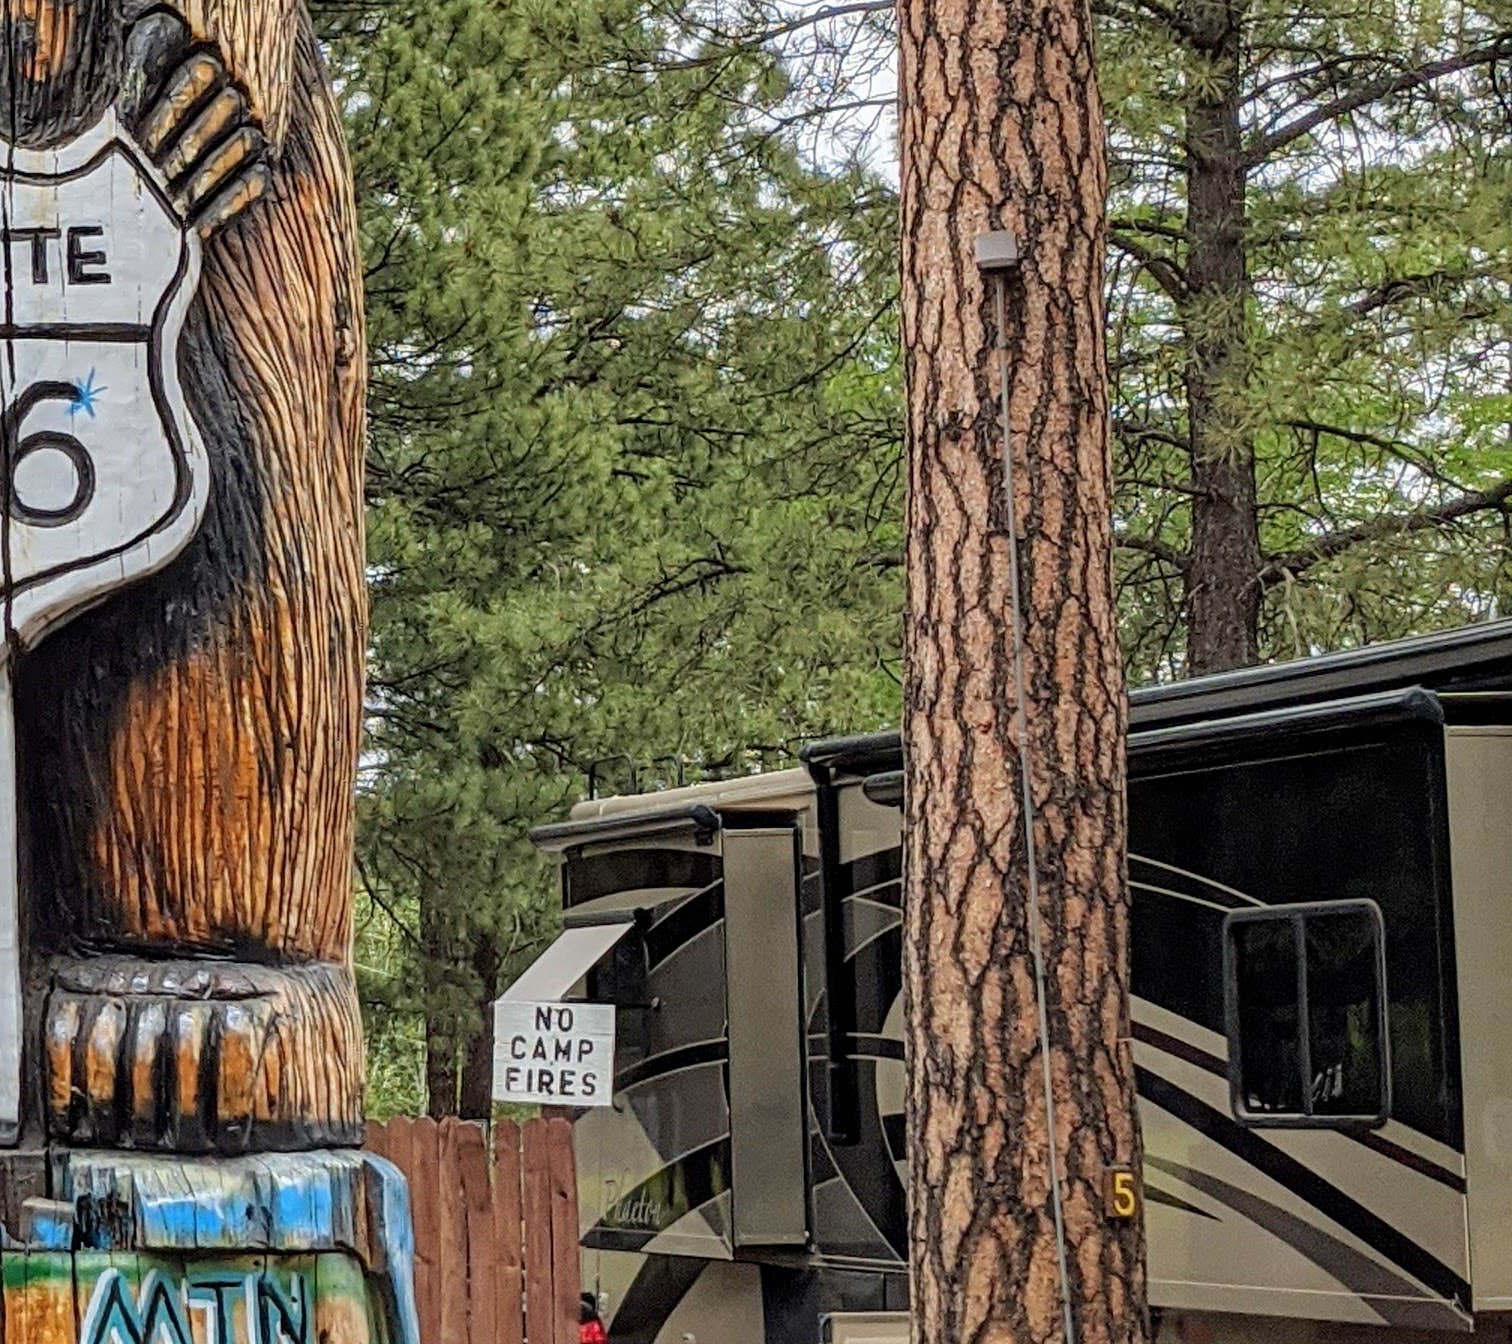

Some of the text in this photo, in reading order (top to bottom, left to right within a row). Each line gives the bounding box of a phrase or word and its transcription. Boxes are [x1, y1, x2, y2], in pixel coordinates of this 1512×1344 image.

[534, 1006, 574, 1032] NO
[510, 1035, 595, 1064] CAMP
[504, 1067, 597, 1097] FIRES
[1113, 1171, 1136, 1218] 5
